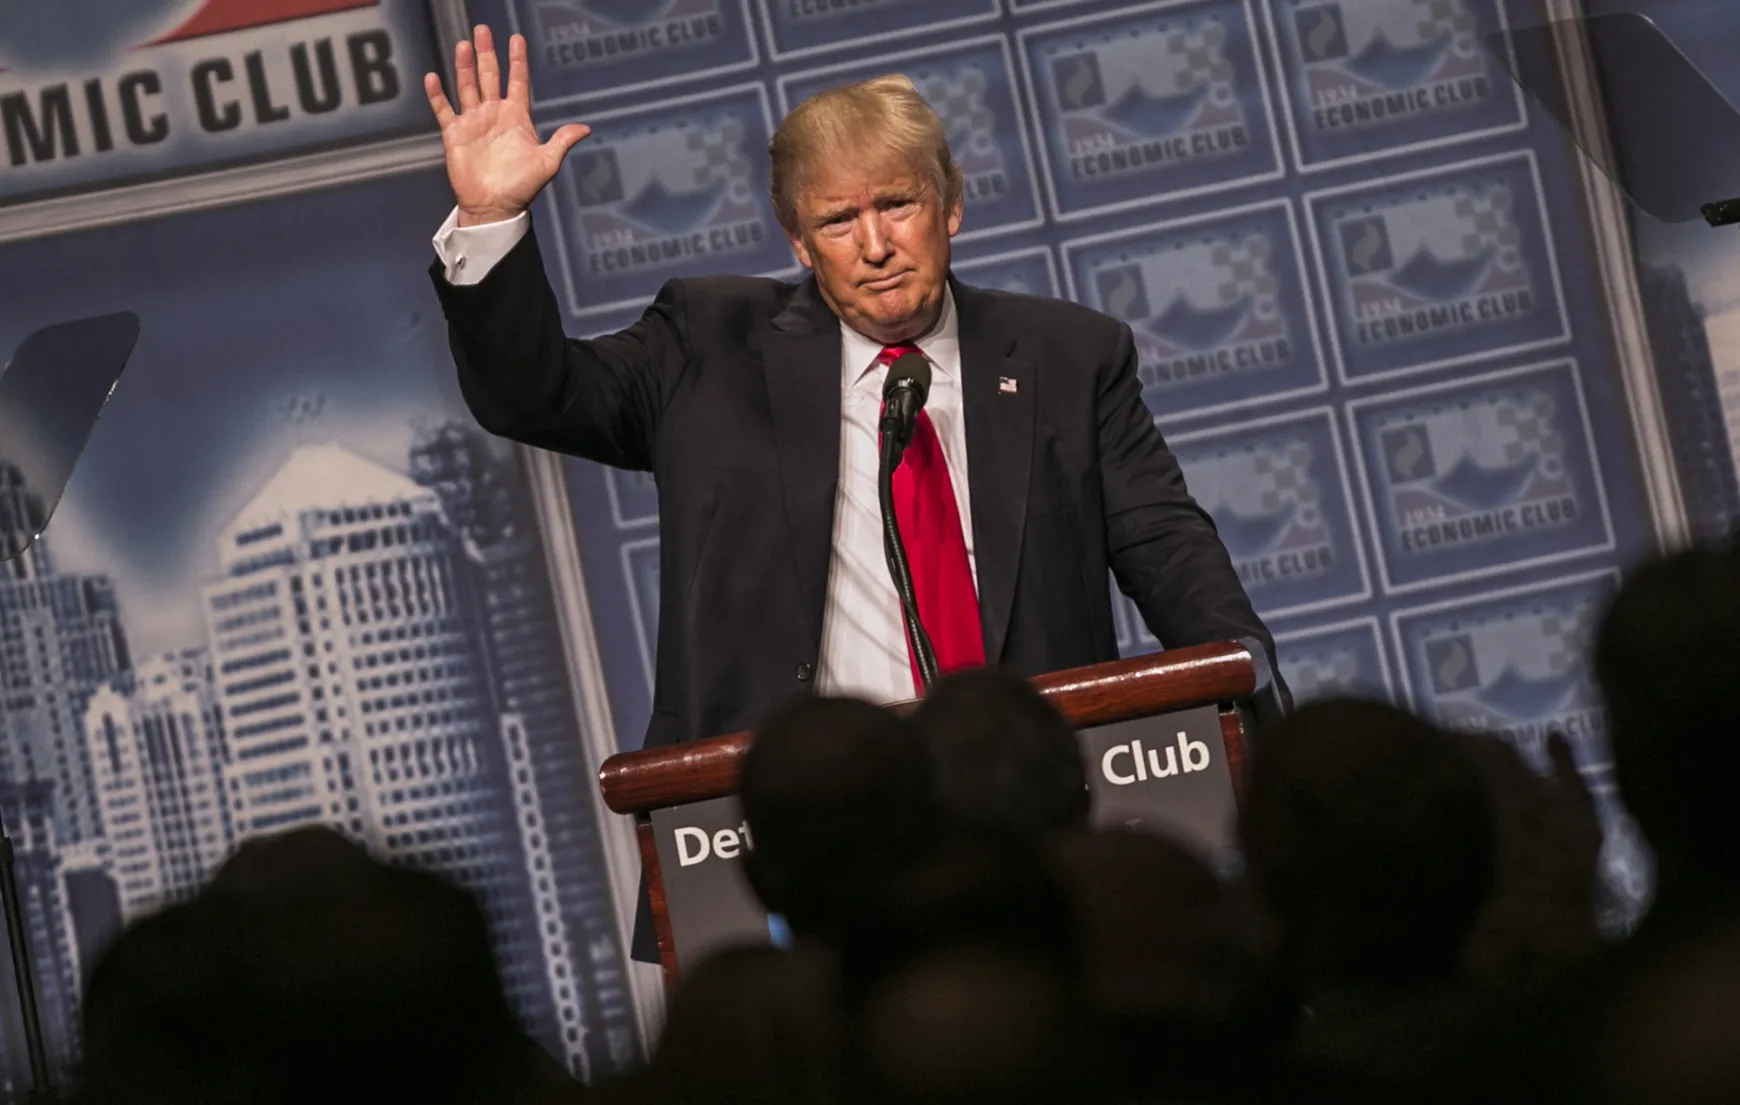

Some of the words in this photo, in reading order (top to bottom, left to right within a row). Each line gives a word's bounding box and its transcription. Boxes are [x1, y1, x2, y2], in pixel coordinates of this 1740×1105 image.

[545, 26, 661, 65] ECONOMIC
[666, 14, 721, 44] CLUB
[0, 70, 170, 166] MIC
[191, 28, 400, 133] CLUB
[1314, 88, 1433, 131] ECONOMIC
[1434, 77, 1489, 106] CLUB
[1071, 137, 1186, 177] ECONOMIC
[1191, 125, 1246, 154] CLUB
[589, 233, 705, 272] ECONOMIC
[709, 221, 763, 250] CLUB
[1358, 303, 1473, 343] ECONOMIC
[1477, 289, 1532, 320] CLUB
[1235, 338, 1290, 367] CLUB
[1401, 508, 1516, 550] ECONOMIC
[1521, 497, 1576, 527] CLUB
[1277, 546, 1333, 576] CLUB
[1100, 730, 1211, 786] Club
[673, 820, 755, 868] Det
